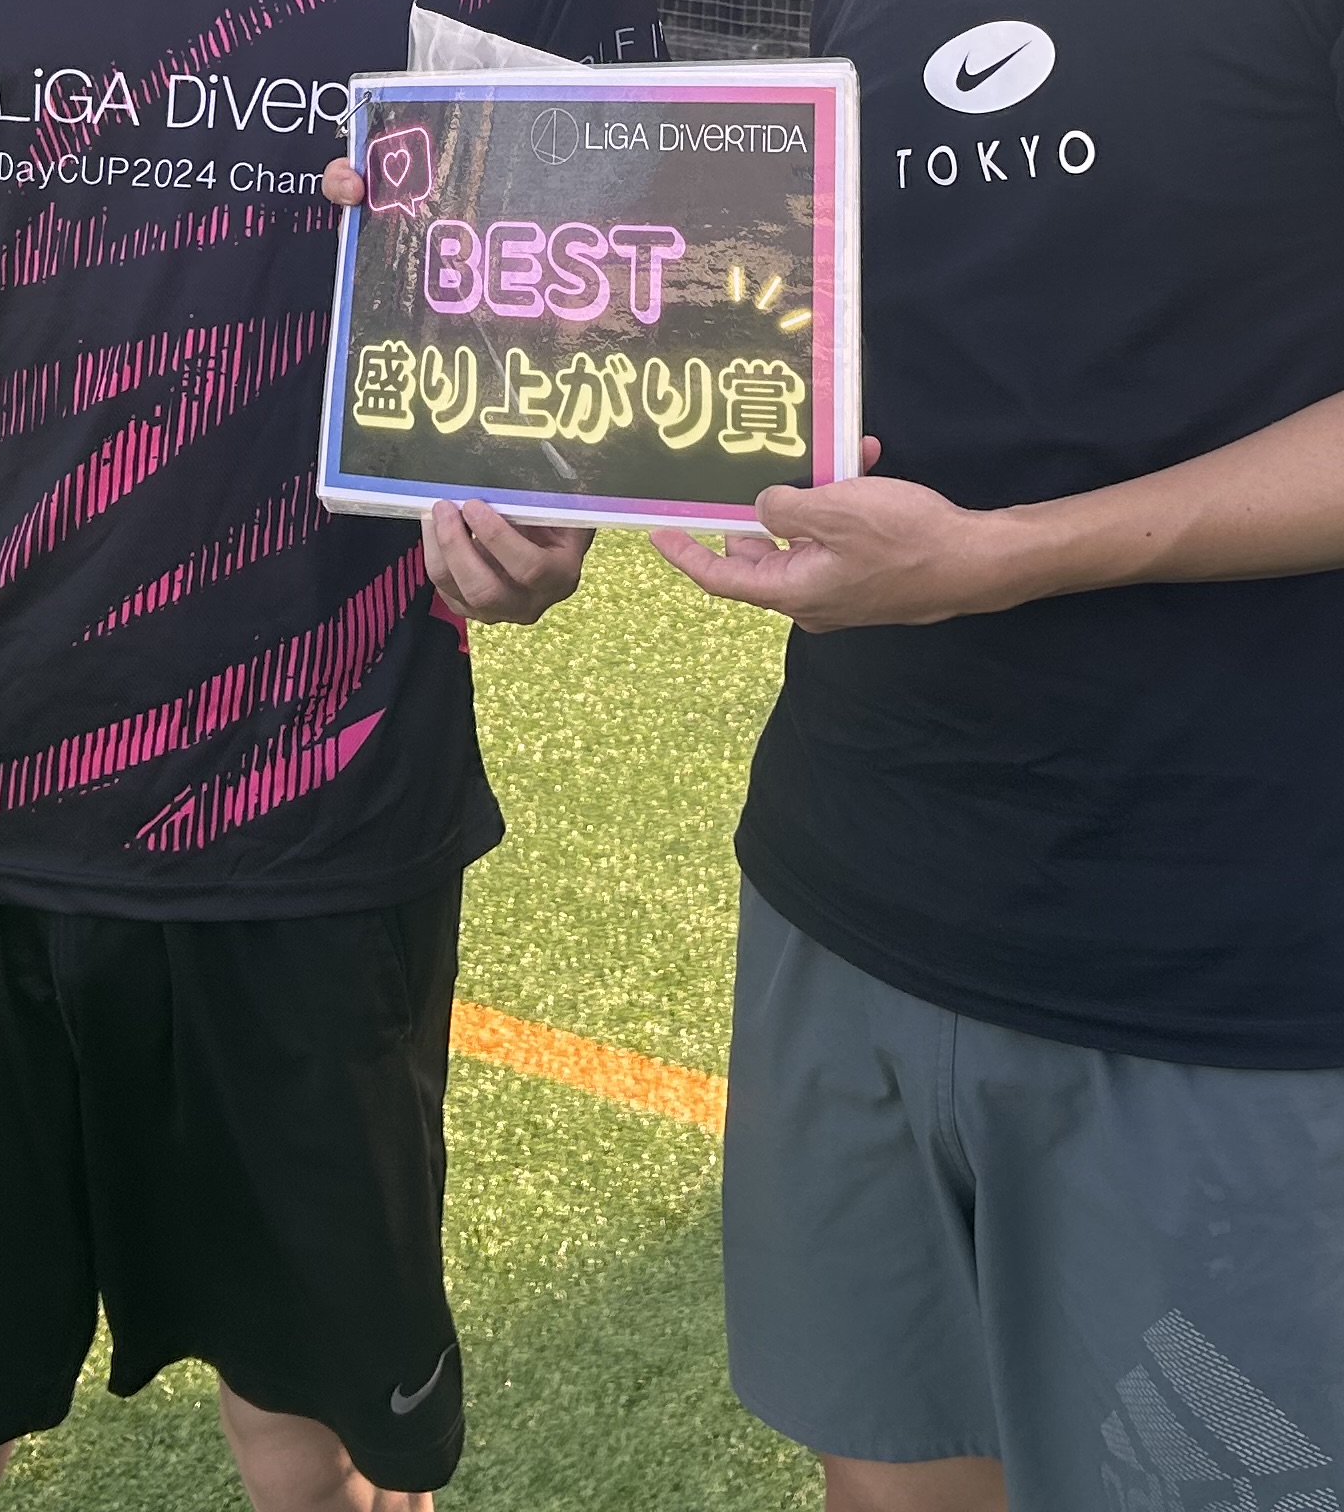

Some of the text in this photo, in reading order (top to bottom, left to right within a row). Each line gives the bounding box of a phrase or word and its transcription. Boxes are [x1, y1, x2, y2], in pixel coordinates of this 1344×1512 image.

[896, 129, 1096, 189] TOKYO
[424, 219, 686, 325] BEST
[353, 339, 807, 458] 盛り上がり賞
